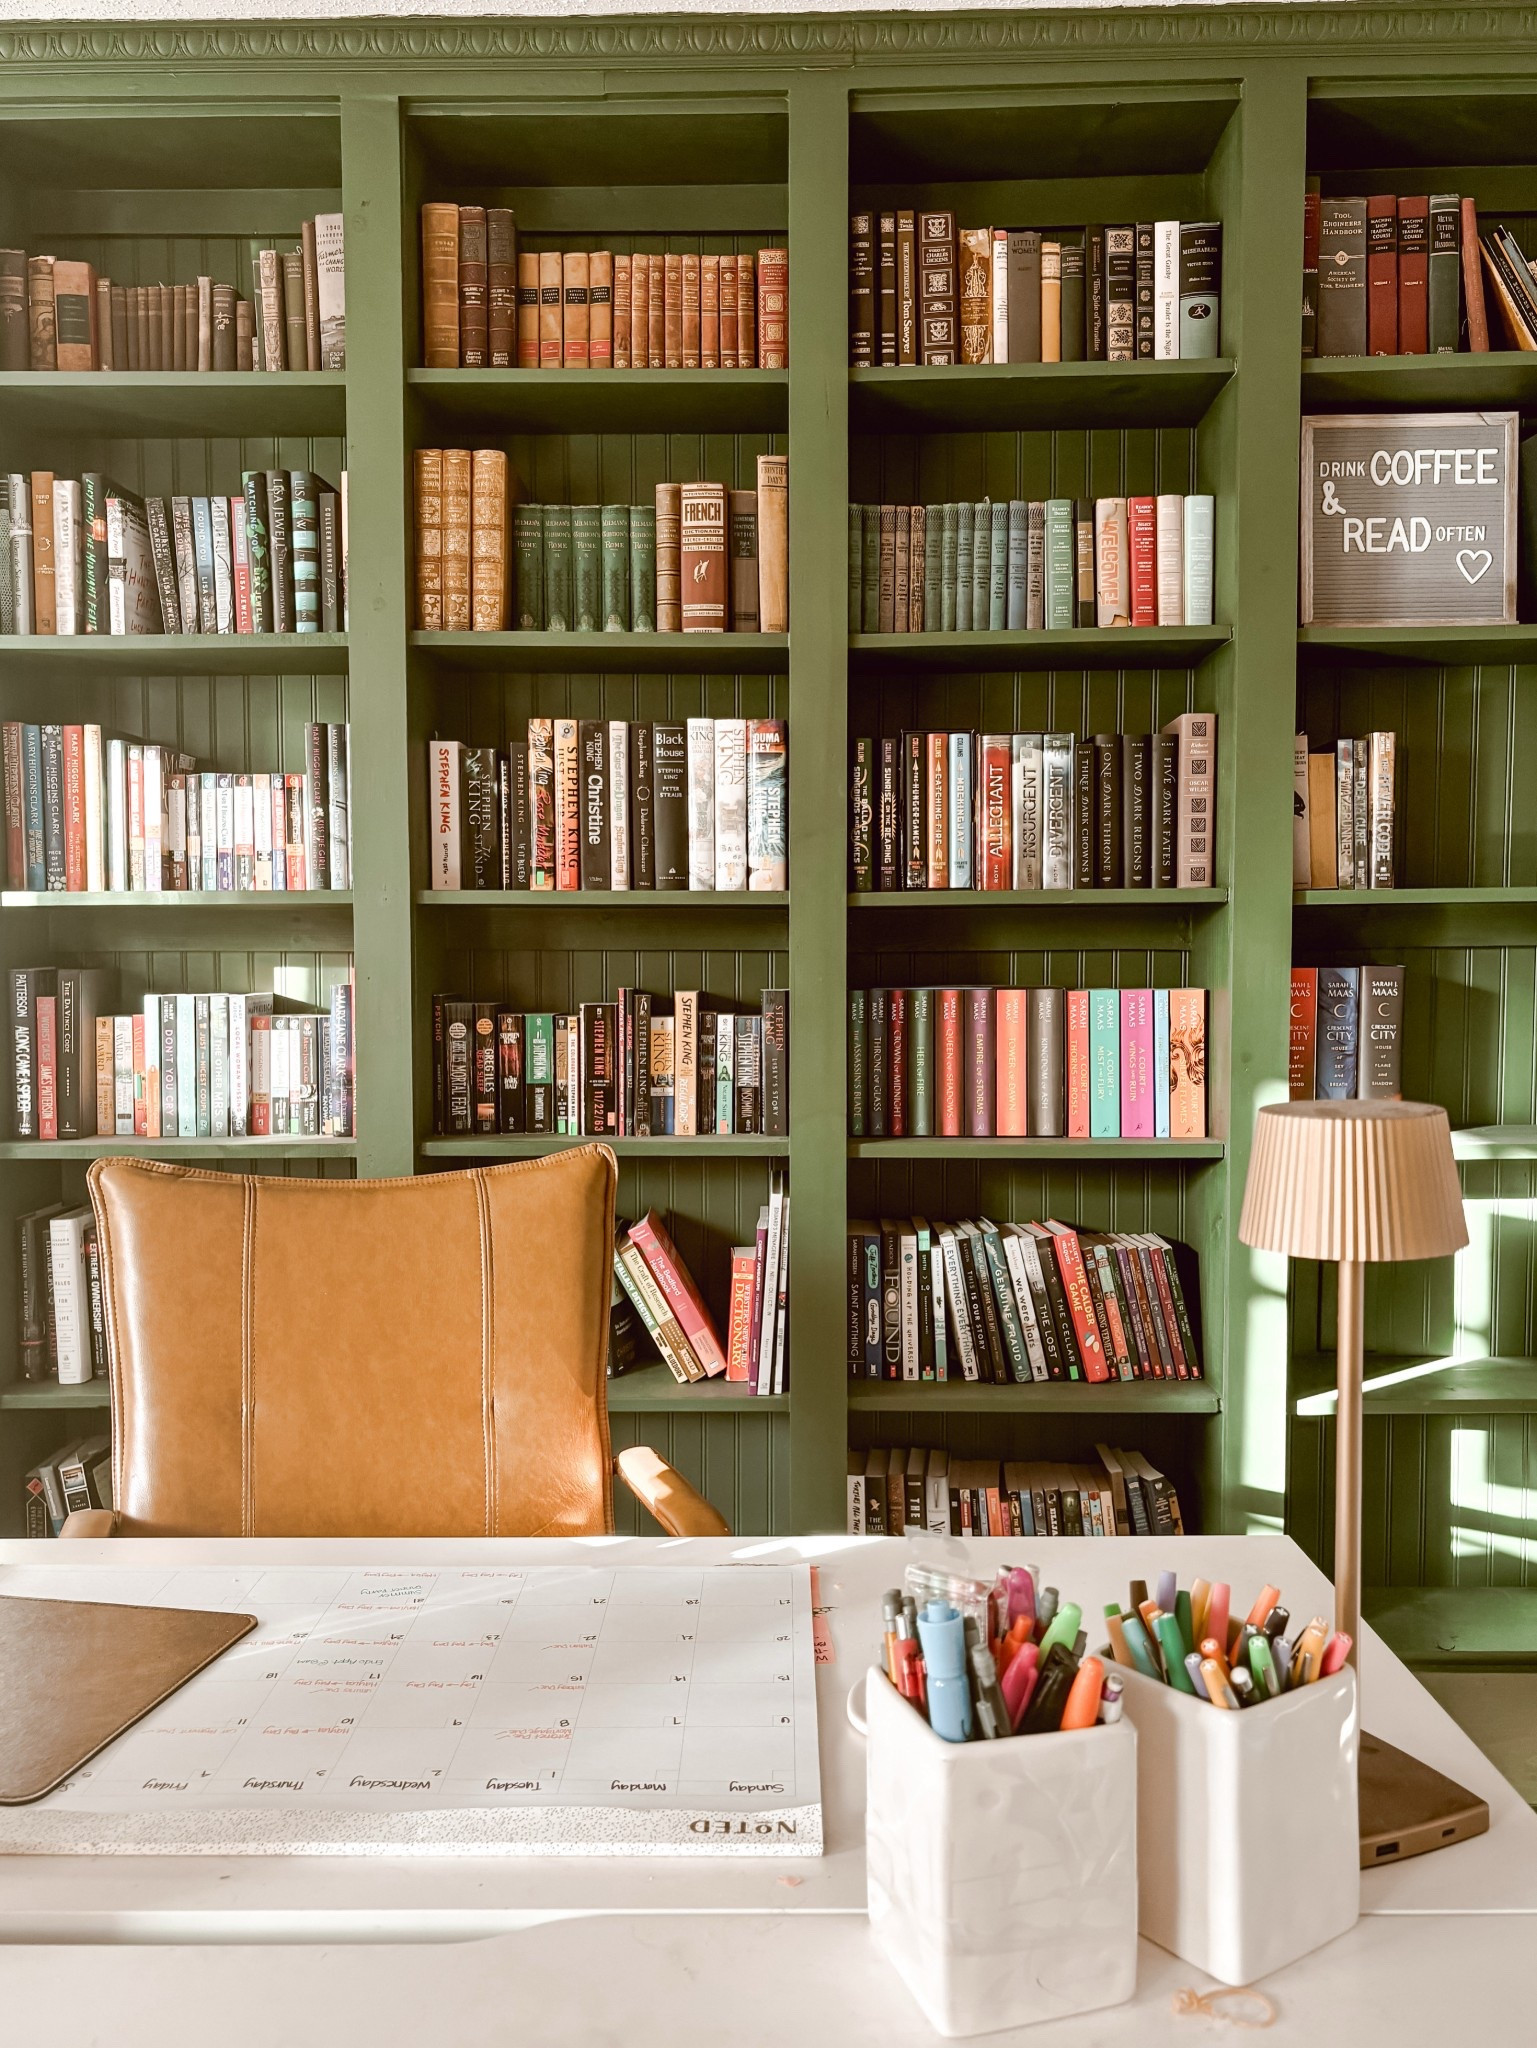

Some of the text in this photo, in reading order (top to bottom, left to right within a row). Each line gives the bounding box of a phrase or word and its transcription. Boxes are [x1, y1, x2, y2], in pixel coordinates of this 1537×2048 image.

[903, 299, 912, 354] Tom Sawyer
[767, 476, 783, 484] DAYS
[1320, 449, 1499, 486] DRINK COFFEE
[248, 481, 259, 551] WATCHING YOU
[273, 479, 285, 549] LISA JEWELL
[684, 503, 721, 522] FRENCH
[1322, 481, 1346, 515] &
[85, 479, 97, 631] LUCY FOLEY THE MIDNIGHT FEAST
[1344, 517, 1485, 552] READ OFTEN
[1101, 520, 1119, 606] WELCOME!
[656, 734, 683, 745] Black
[656, 747, 684, 757] House
[753, 733, 779, 742] DUMA
[48, 740, 60, 835] MARY HIGGINS CLARK
[438, 749, 451, 833] STEPHEN KING
[1080, 759, 1088, 791] THREE
[468, 780, 481, 825] KING
[482, 774, 491, 831] STEPHEN
[567, 747, 579, 868] STEPHEN KING
[588, 775, 603, 845] Christine
[768, 788, 780, 845] STEPHEN
[957, 778, 965, 843] MOCKINGJAY
[990, 764, 1003, 857] ALLEGIANT
[1023, 766, 1036, 858] INSURGENT
[1050, 764, 1063, 858] DIVERGENT
[1134, 753, 1142, 871] TWO DARK REIGNS
[1162, 757, 1175, 866] FIVE DARK FATES
[16, 974, 27, 1018] PATTERSON
[1328, 989, 1354, 997] MAAS
[1372, 988, 1398, 996] MAAS
[682, 998, 693, 1065] STEPHEN KING
[766, 1012, 775, 1045] KING
[1327, 1032, 1353, 1040] CITY
[1371, 1031, 1396, 1040] CITY
[165, 1030, 174, 1116] DON'T YOU CRY
[654, 1033, 664, 1072] KING
[874, 1037, 882, 1072] THRONE
[917, 1046, 925, 1067] HEIR
[639, 1064, 647, 1095] KING
[679, 1078, 688, 1123] REGULATORS
[874, 1087, 882, 1112] GLASS
[594, 1091, 604, 1132] 11/22/63
[89, 1242, 103, 1332] EXTREME OWNERSHIP
[615, 1262, 655, 1327] FALLACY DETECTIVE
[650, 1259, 671, 1294] Handbook
[656, 1256, 682, 1297] The Bedford
[1069, 1283, 1083, 1312] GAME
[1075, 1264, 1095, 1326] THE CALDER
[732, 1283, 745, 1368] DICTIONARY
[885, 1276, 900, 1362] FOUND
[947, 1249, 972, 1364] EVERYTHING EVERYTHING
[995, 1269, 1021, 1362] GENUINE FRAUD
[1016, 1278, 1035, 1348] we were liars
[851, 1311, 859, 1357] ANYTHING
[1039, 1304, 1057, 1359] THE LOST
[1057, 1298, 1075, 1362] THE CELLAR
[560, 1719, 570, 1727] 8
[143, 1778, 189, 1790] Friday
[243, 1778, 304, 1790] Thursday
[350, 1776, 431, 1789] Wednesday
[486, 1778, 542, 1791] Tuesday
[611, 1780, 667, 1792] Monday
[729, 1780, 785, 1793] Sunday
[689, 1820, 796, 1834] NOTED
